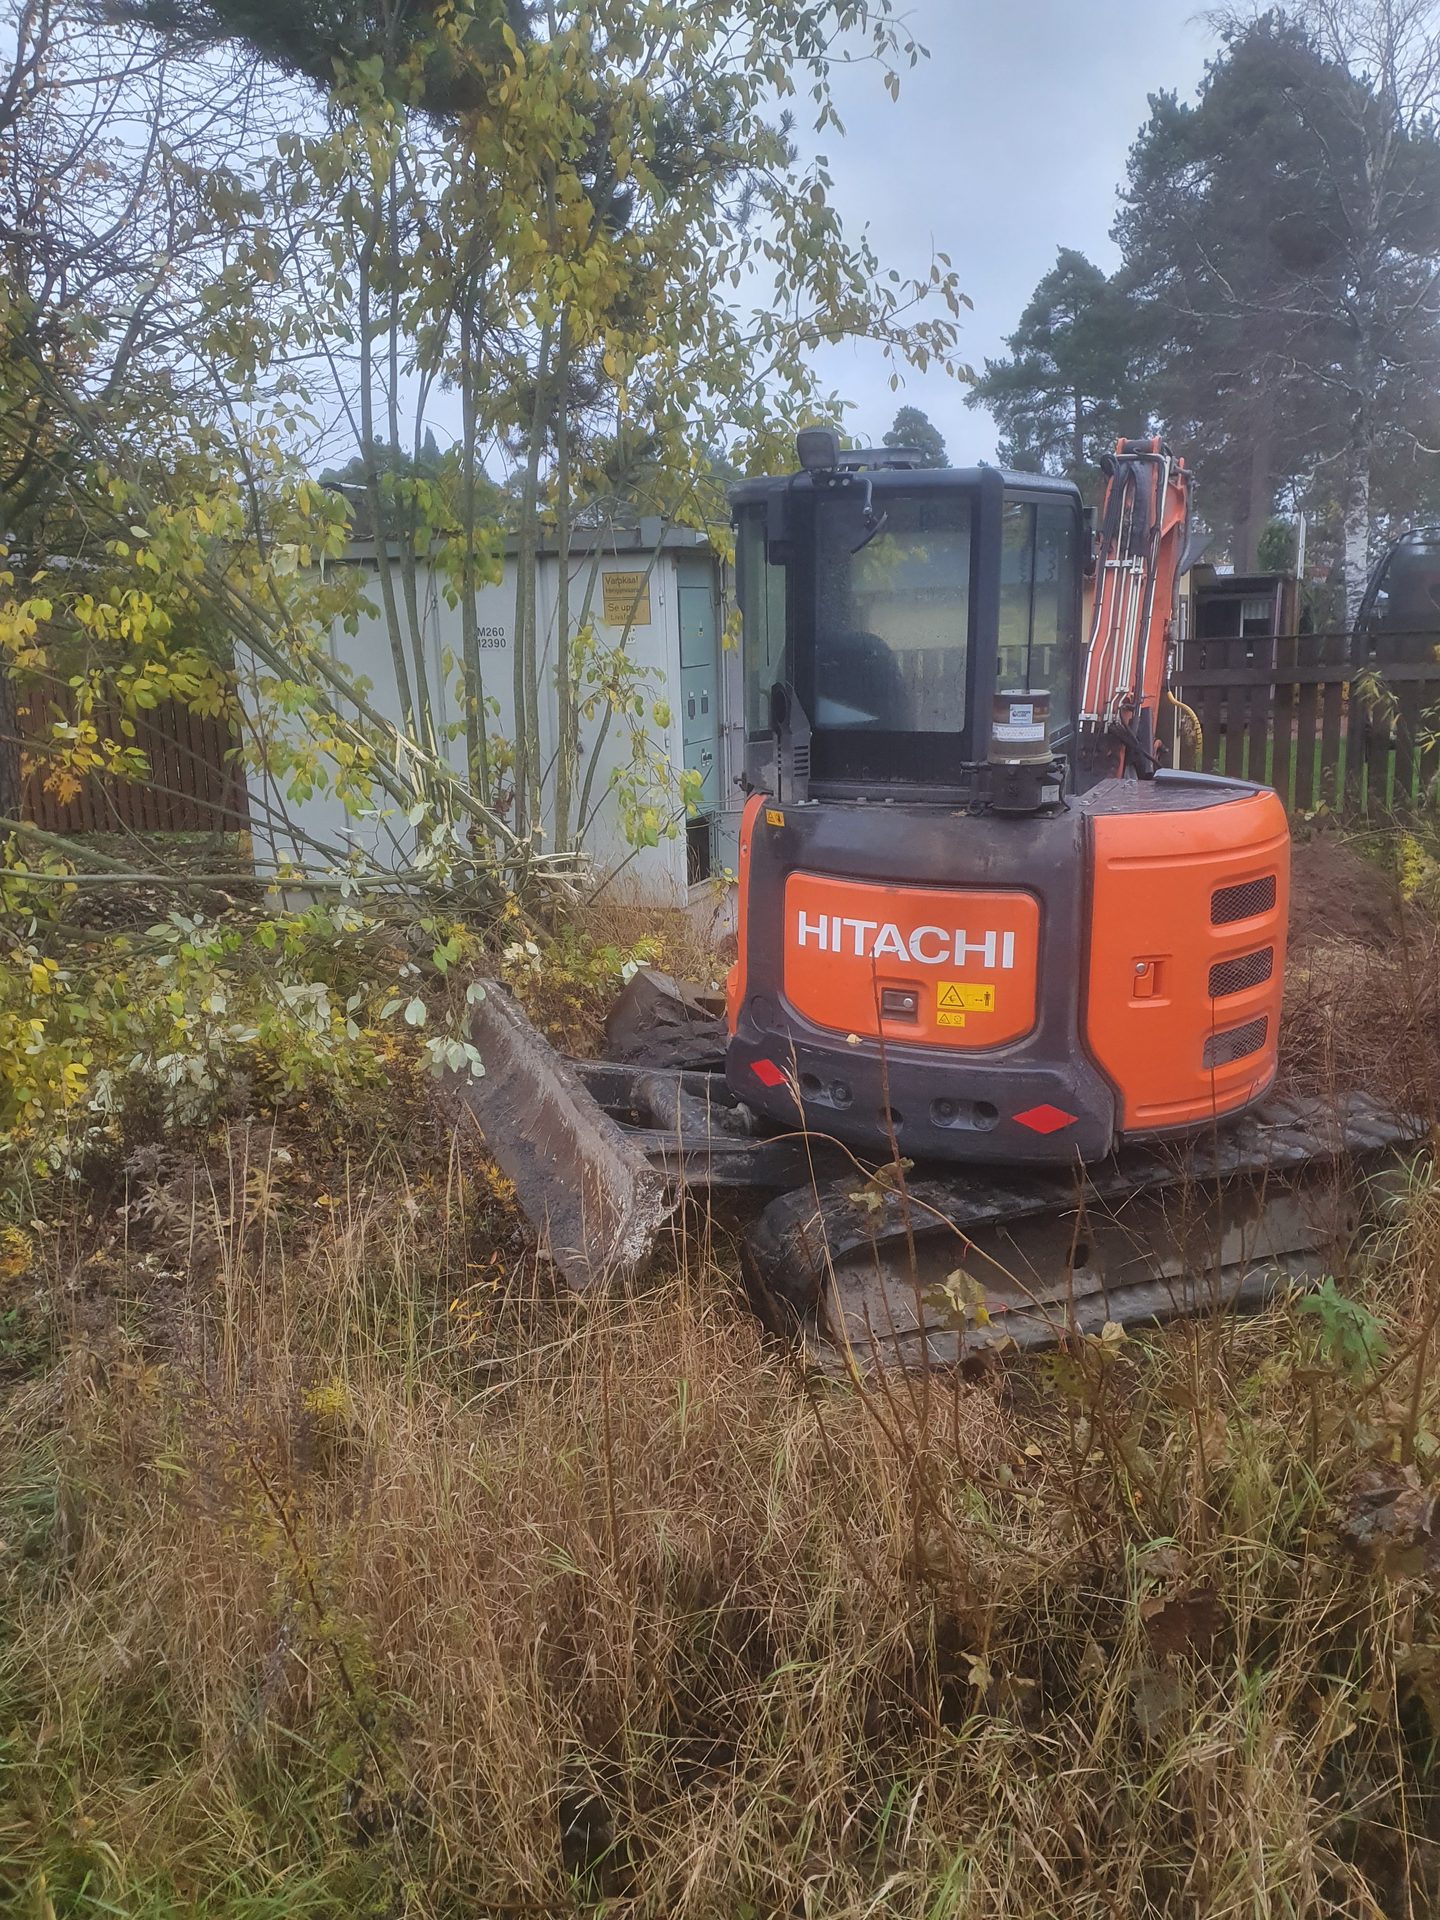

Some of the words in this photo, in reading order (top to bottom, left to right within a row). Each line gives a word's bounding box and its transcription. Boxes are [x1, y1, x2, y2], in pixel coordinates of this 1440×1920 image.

[608, 603, 619, 611] Se
[477, 626, 505, 637] M260
[478, 638, 507, 648] 12390
[798, 910, 1015, 969] HITACHI
